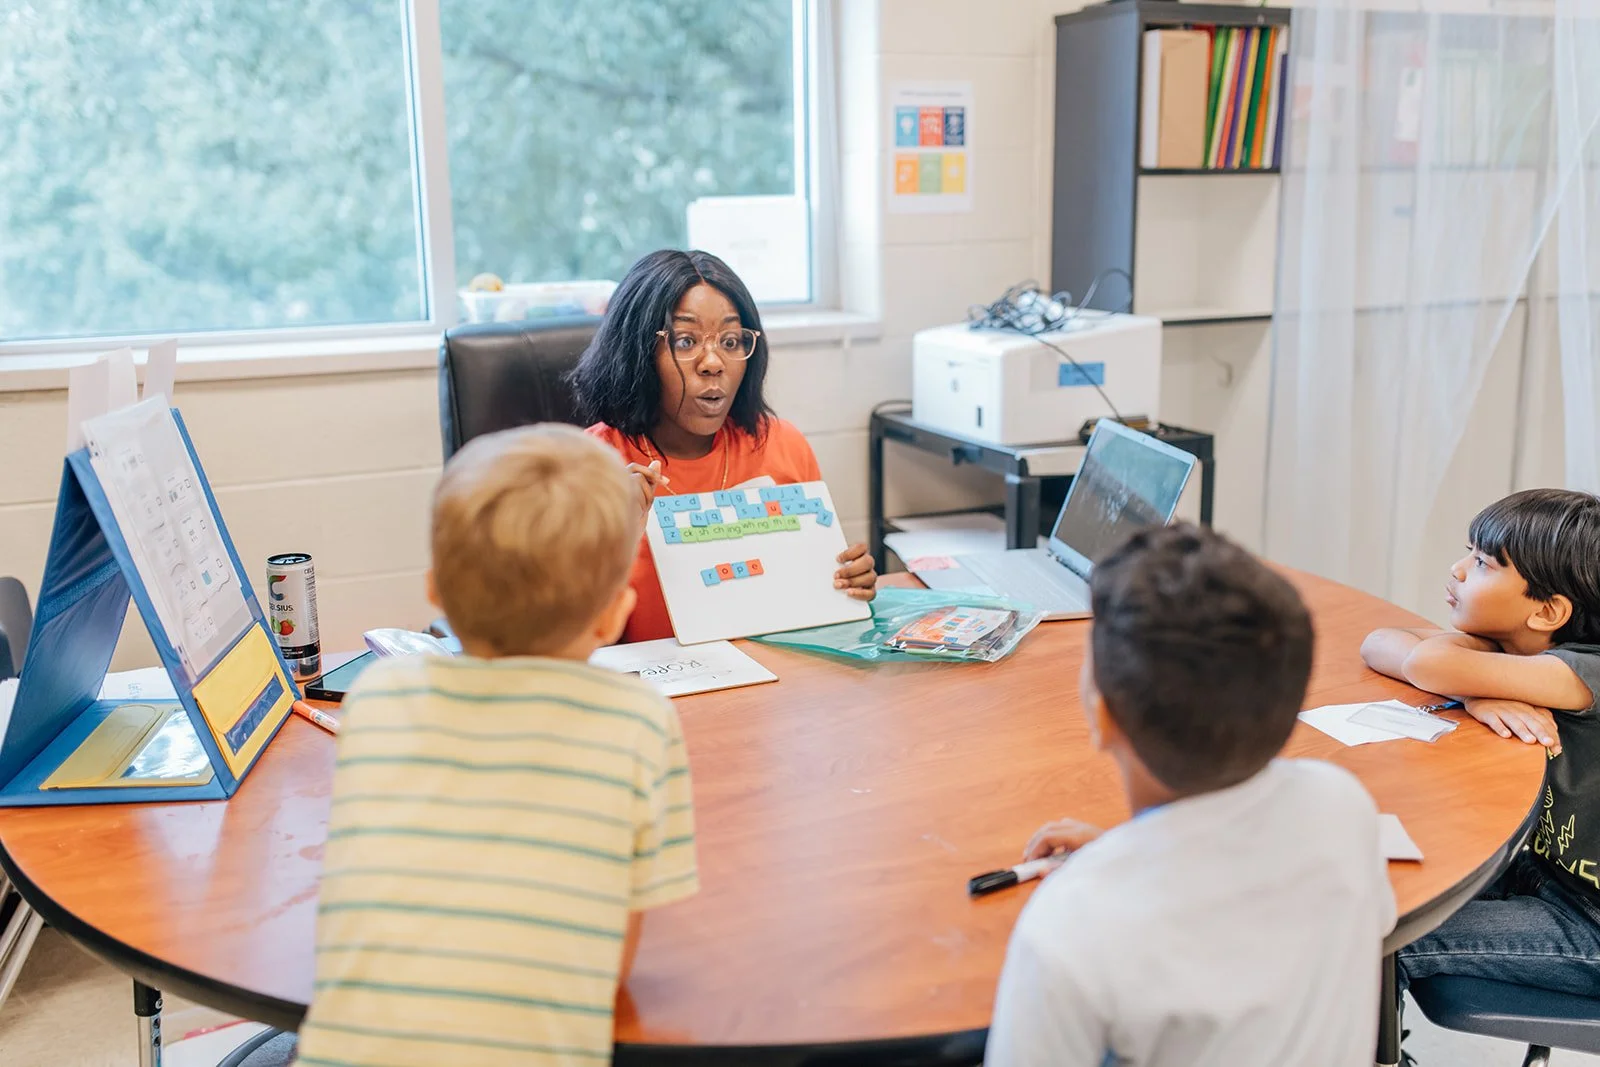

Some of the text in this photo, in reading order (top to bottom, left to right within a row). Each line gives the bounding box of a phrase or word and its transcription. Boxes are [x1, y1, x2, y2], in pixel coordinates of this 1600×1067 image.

[658, 500, 666, 508] b
[689, 496, 697, 505] d
[683, 529, 693, 537] ck
[698, 527, 709, 536] sh
[712, 526, 725, 534] ch
[727, 525, 742, 536] ing
[708, 563, 758, 580] rope
